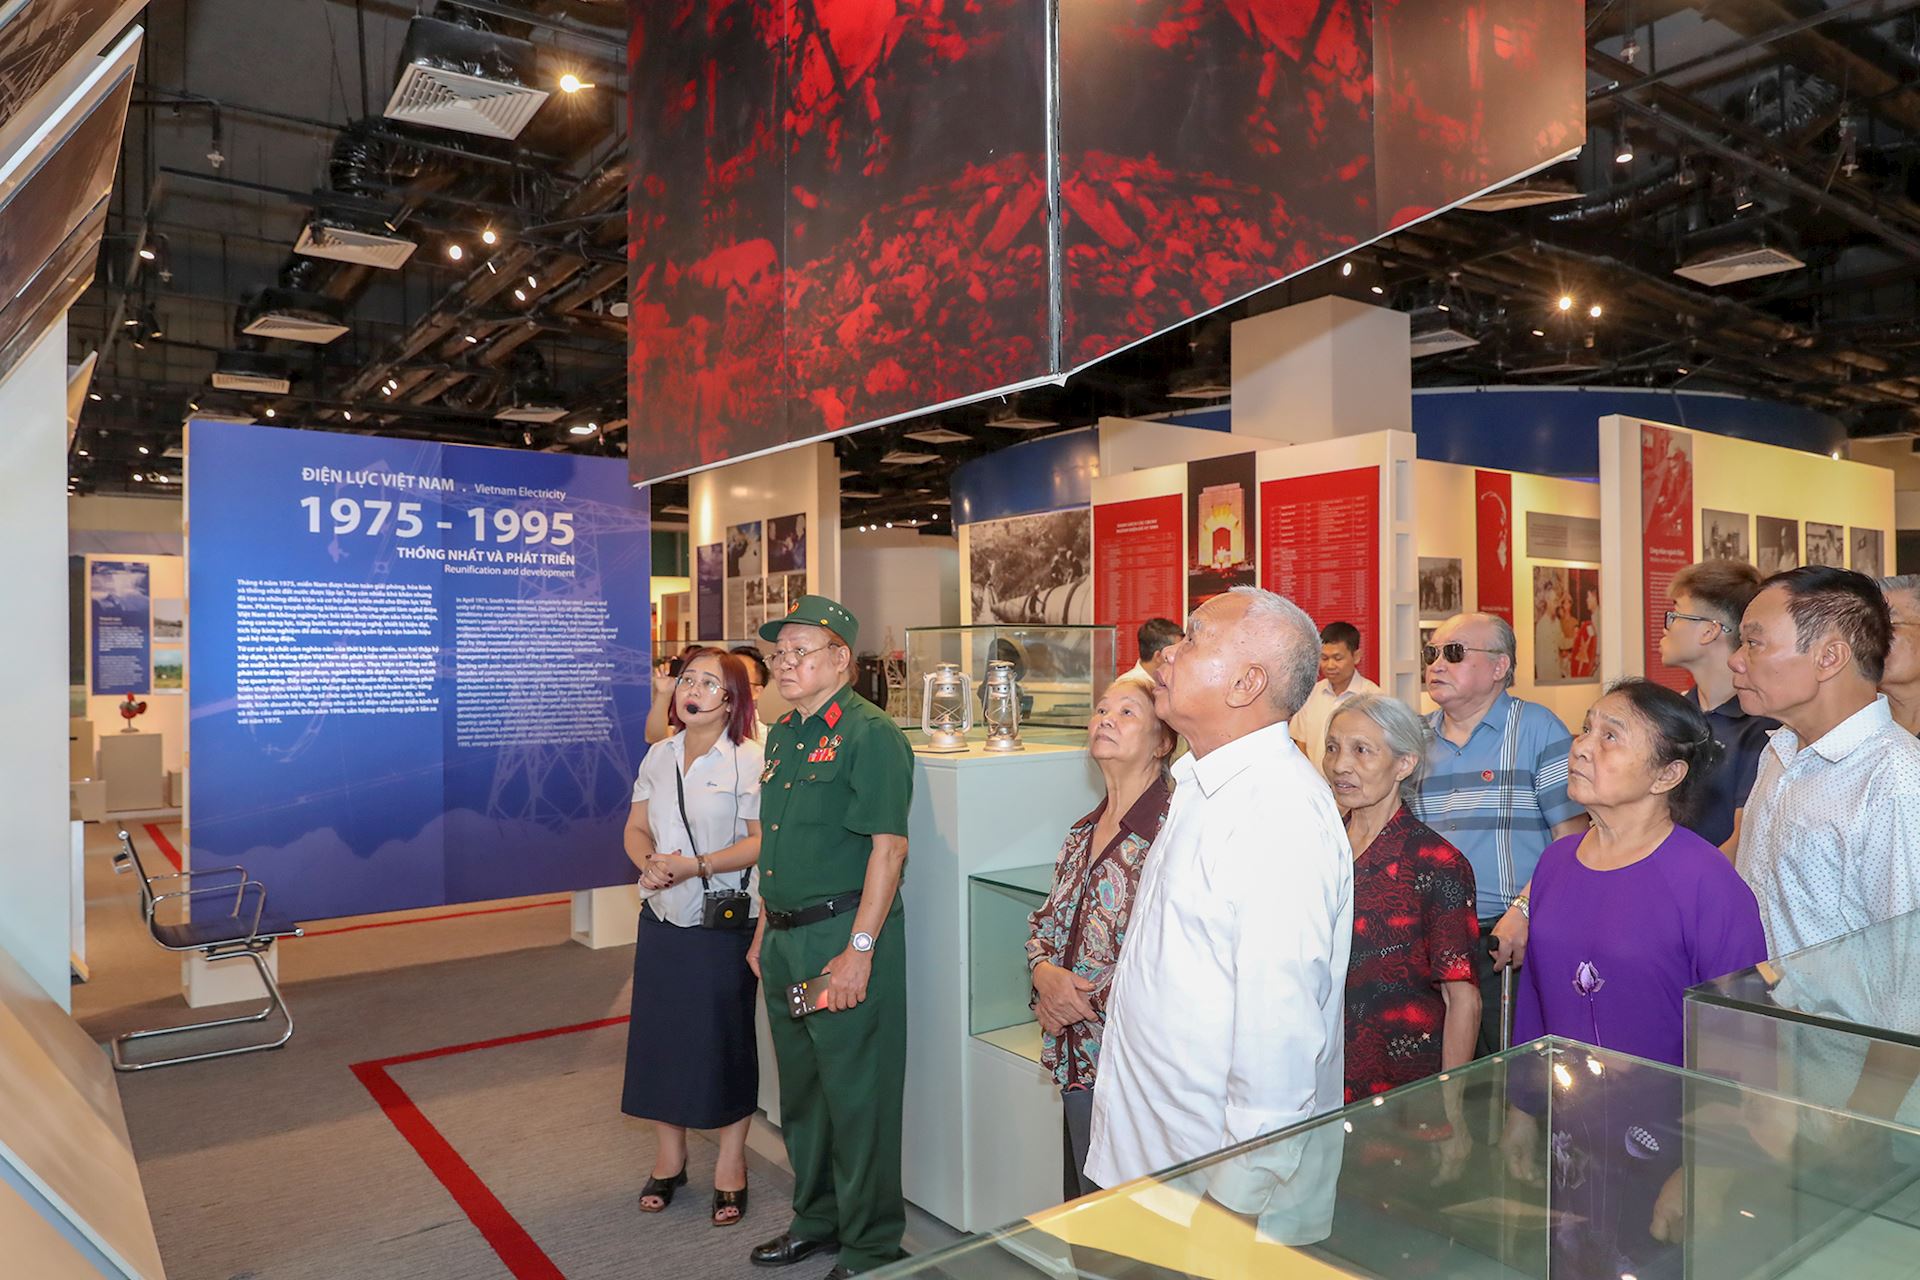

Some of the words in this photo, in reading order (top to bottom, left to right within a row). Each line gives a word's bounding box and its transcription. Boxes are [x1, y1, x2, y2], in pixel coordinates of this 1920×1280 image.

[302, 466, 342, 486] ĐIỆN
[346, 469, 380, 489] LỰC
[380, 472, 415, 492] VIỆT
[418, 476, 454, 492] NAM
[474, 484, 516, 496] Vietnam
[518, 486, 566, 501] Electricity
[300, 496, 424, 538] 1975
[467, 507, 575, 546] 1995
[397, 545, 446, 560] THỐNG
[448, 547, 485, 562] NHẤT
[486, 550, 504, 563] VÀ
[506, 551, 540, 564] PHÁT
[540, 550, 575, 566] TRIỂN
[444, 565, 500, 576] Reunification
[502, 566, 518, 576] and
[520, 566, 575, 578] development
